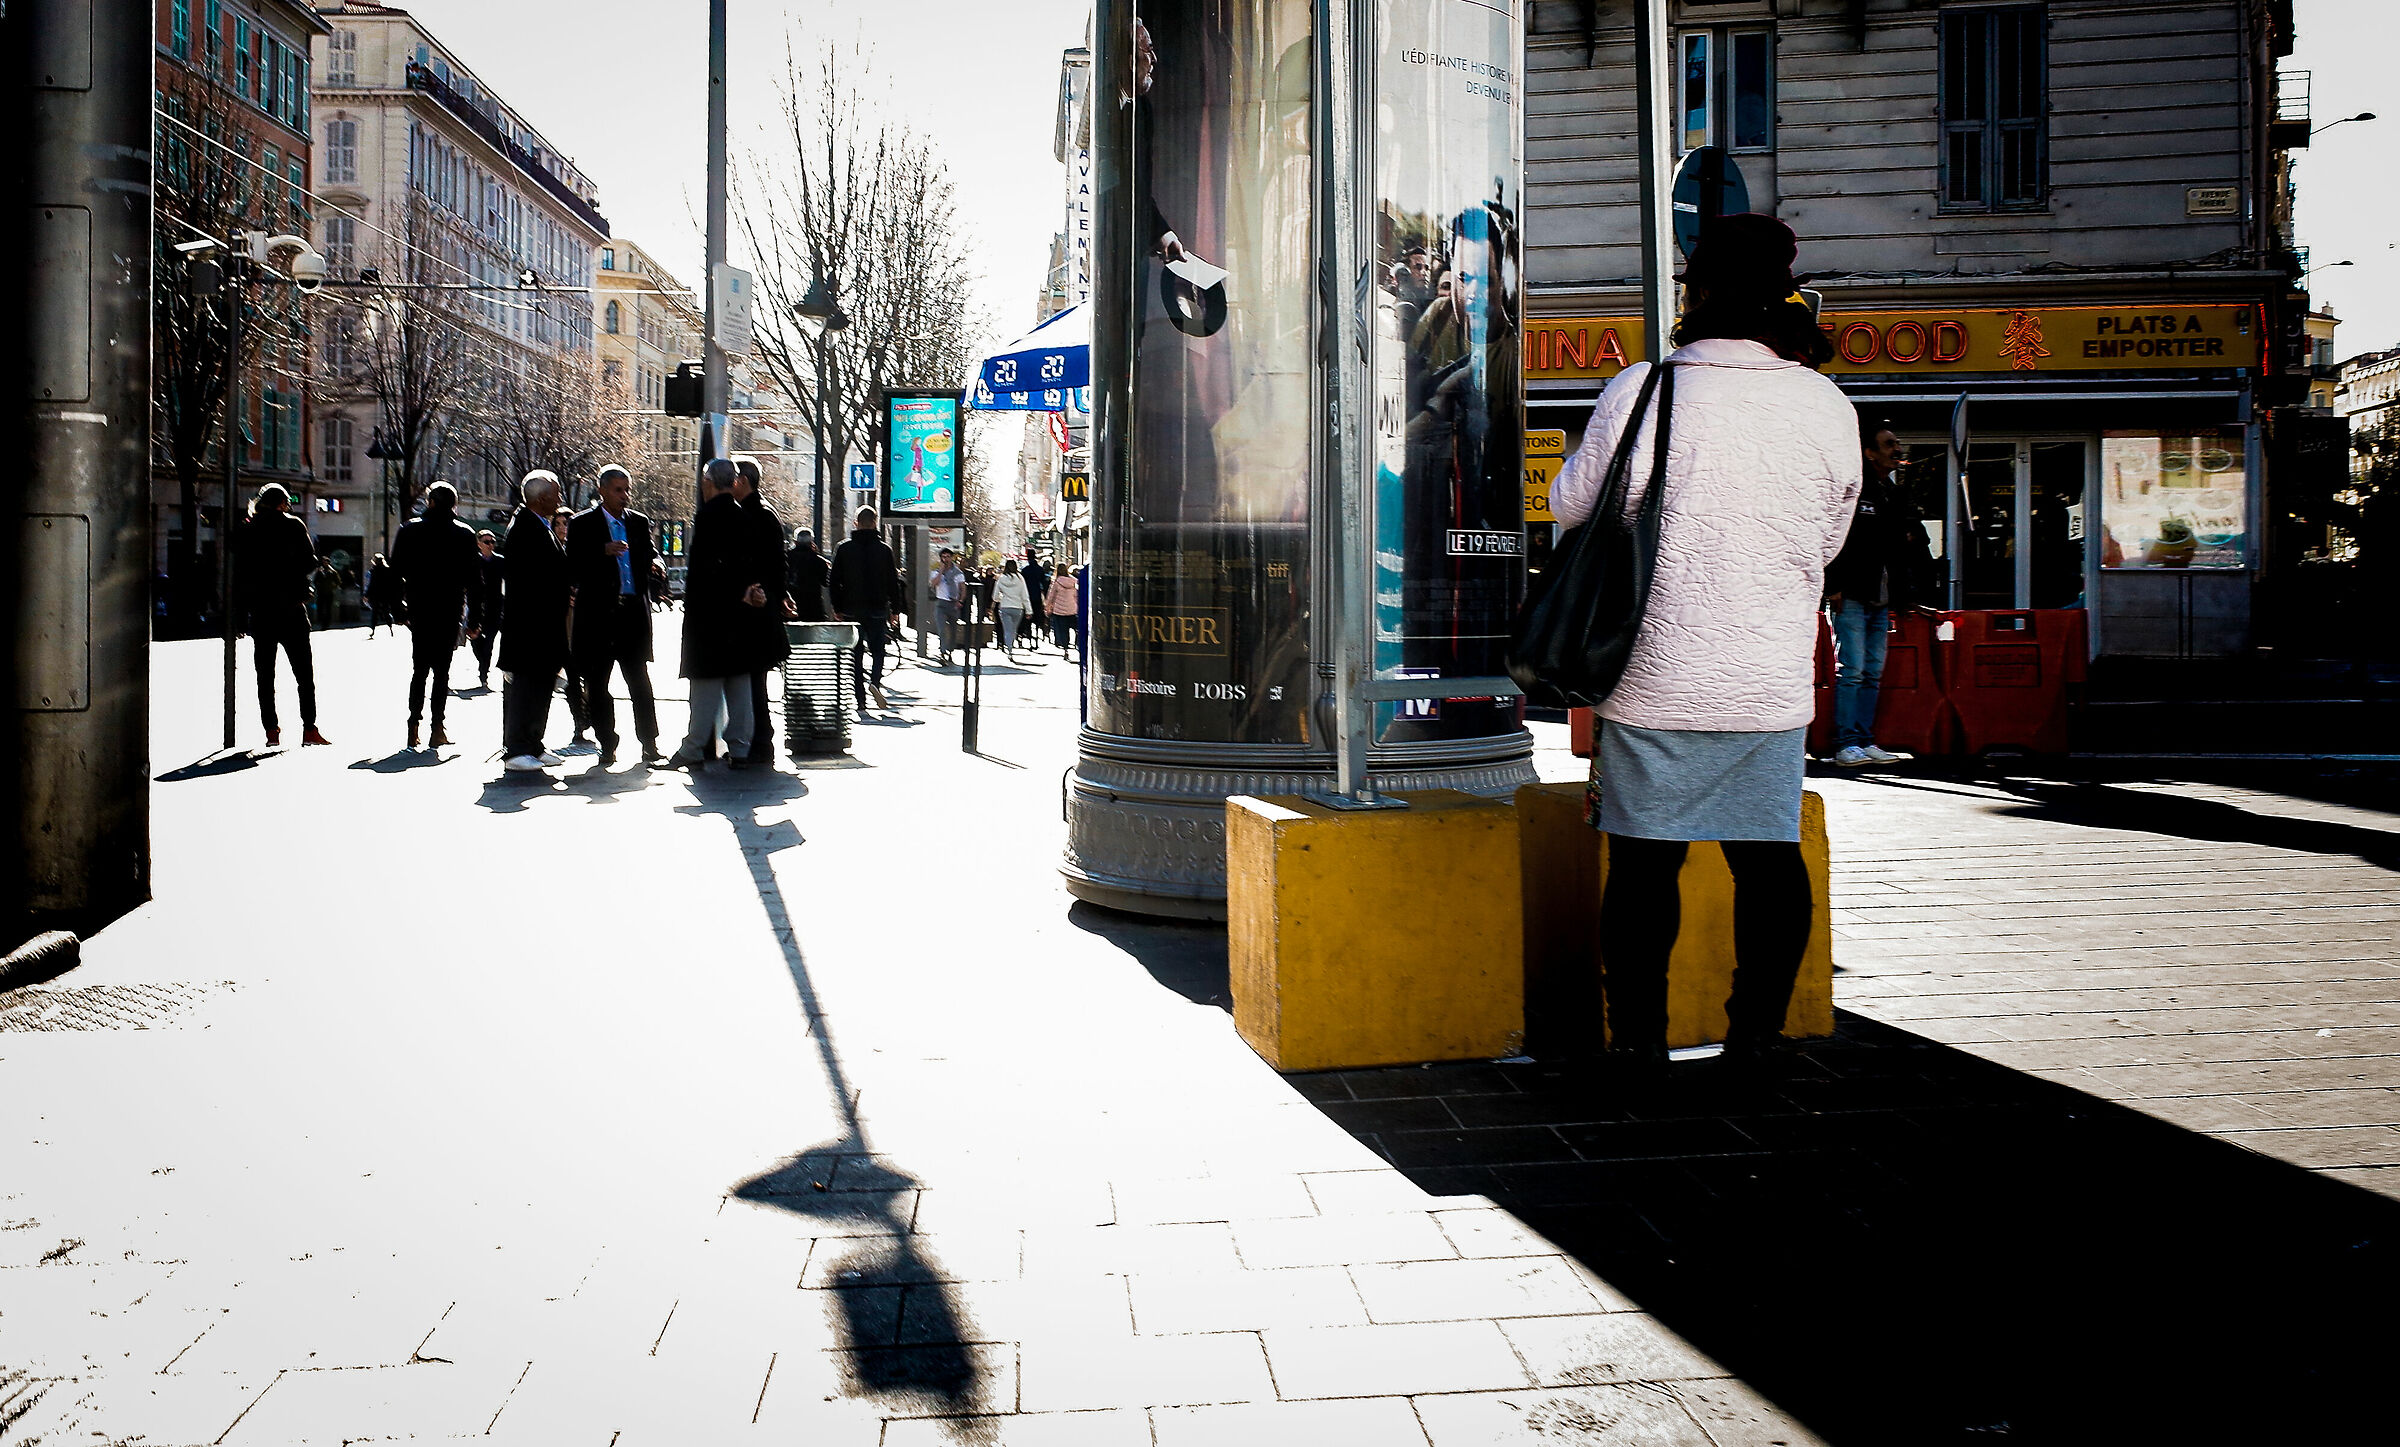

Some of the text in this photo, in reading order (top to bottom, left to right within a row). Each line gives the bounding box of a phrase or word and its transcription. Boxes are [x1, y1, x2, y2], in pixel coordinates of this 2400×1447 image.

[1402, 48, 1467, 71] L'ÉDIFIANTE
[1466, 81, 1500, 100] DEVENU
[2097, 315, 2203, 335] PLATS A
[1524, 328, 1629, 369] INA
[2083, 338, 2224, 358] EMPORTER
[994, 355, 1065, 383] 20 20
[1451, 534, 1466, 552] LE
[1468, 534, 1484, 552] 19
[1193, 682, 1247, 701] L'OBS
